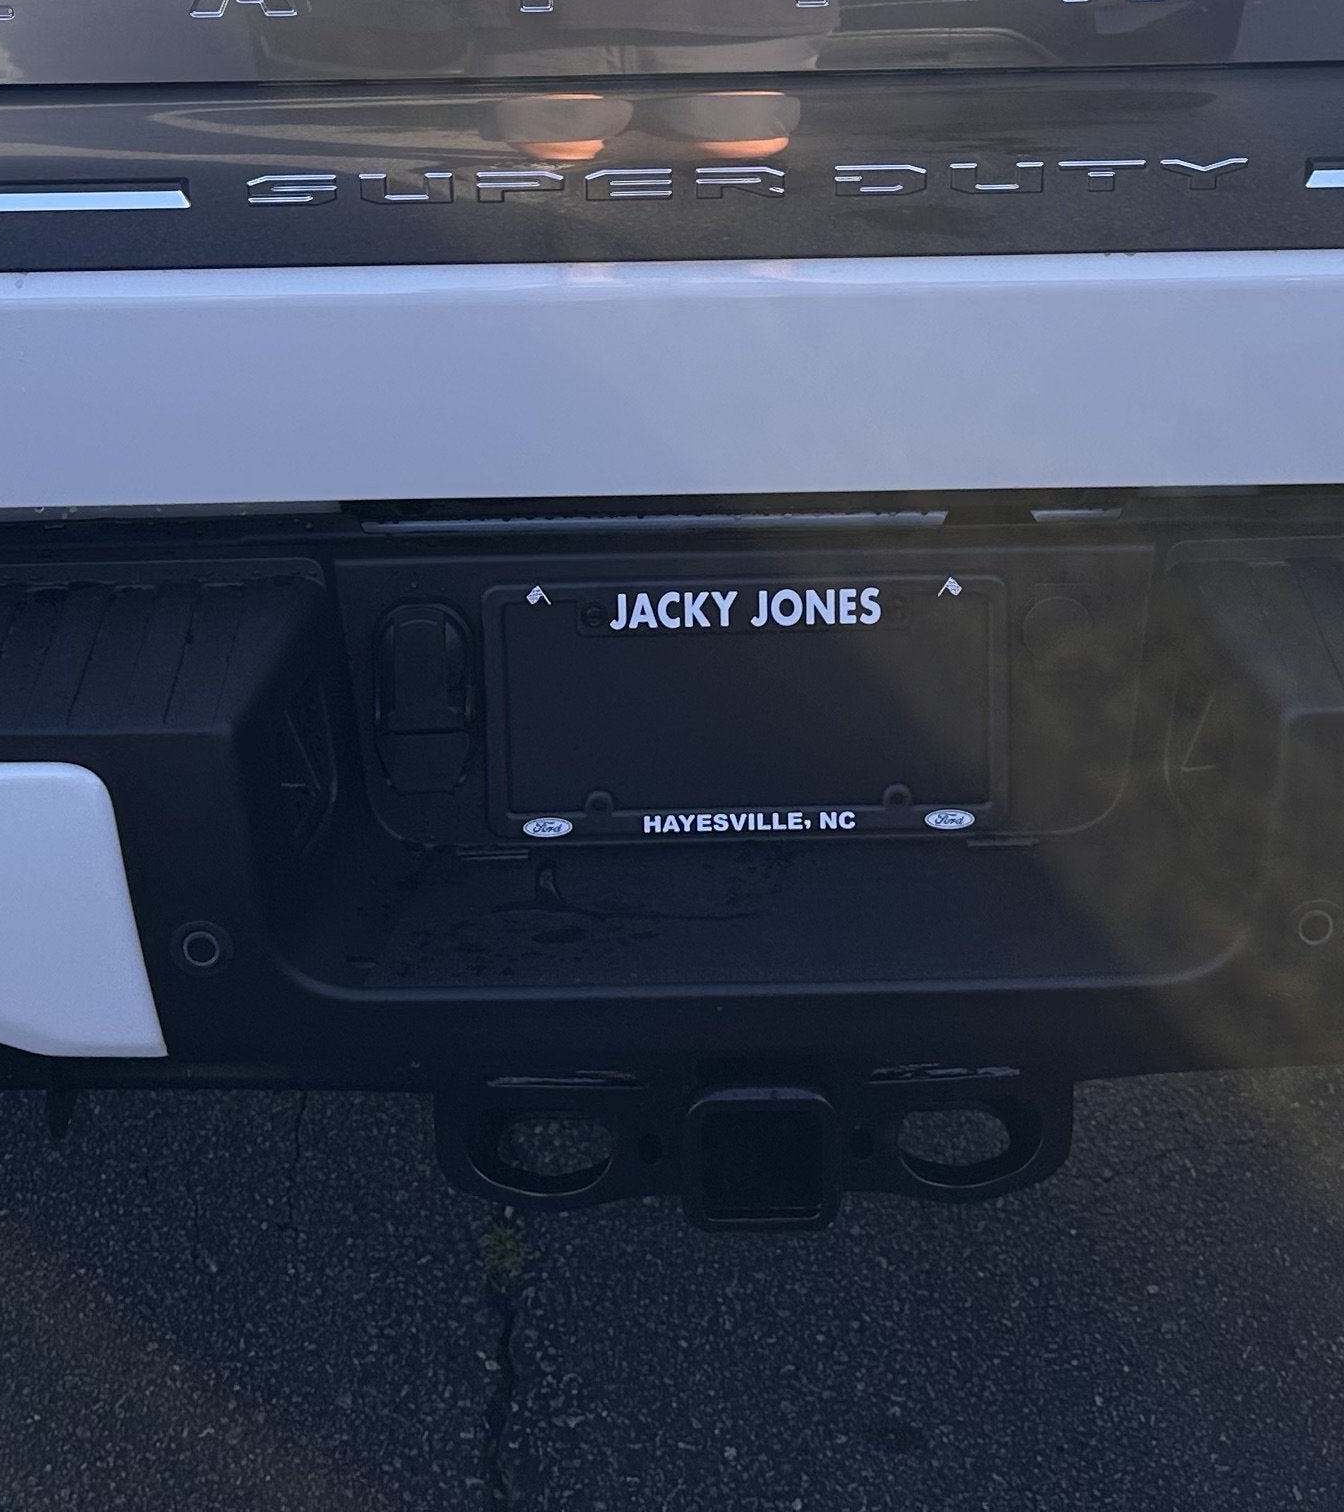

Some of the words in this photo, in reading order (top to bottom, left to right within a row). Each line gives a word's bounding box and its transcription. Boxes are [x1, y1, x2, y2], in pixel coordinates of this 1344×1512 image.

[246, 166, 786, 206] SUPER
[833, 157, 1250, 198] DUTY
[609, 591, 738, 631] JACKY
[750, 587, 881, 627] JONES
[643, 812, 811, 833] HAYESVILLE,
[819, 811, 856, 830] NC
